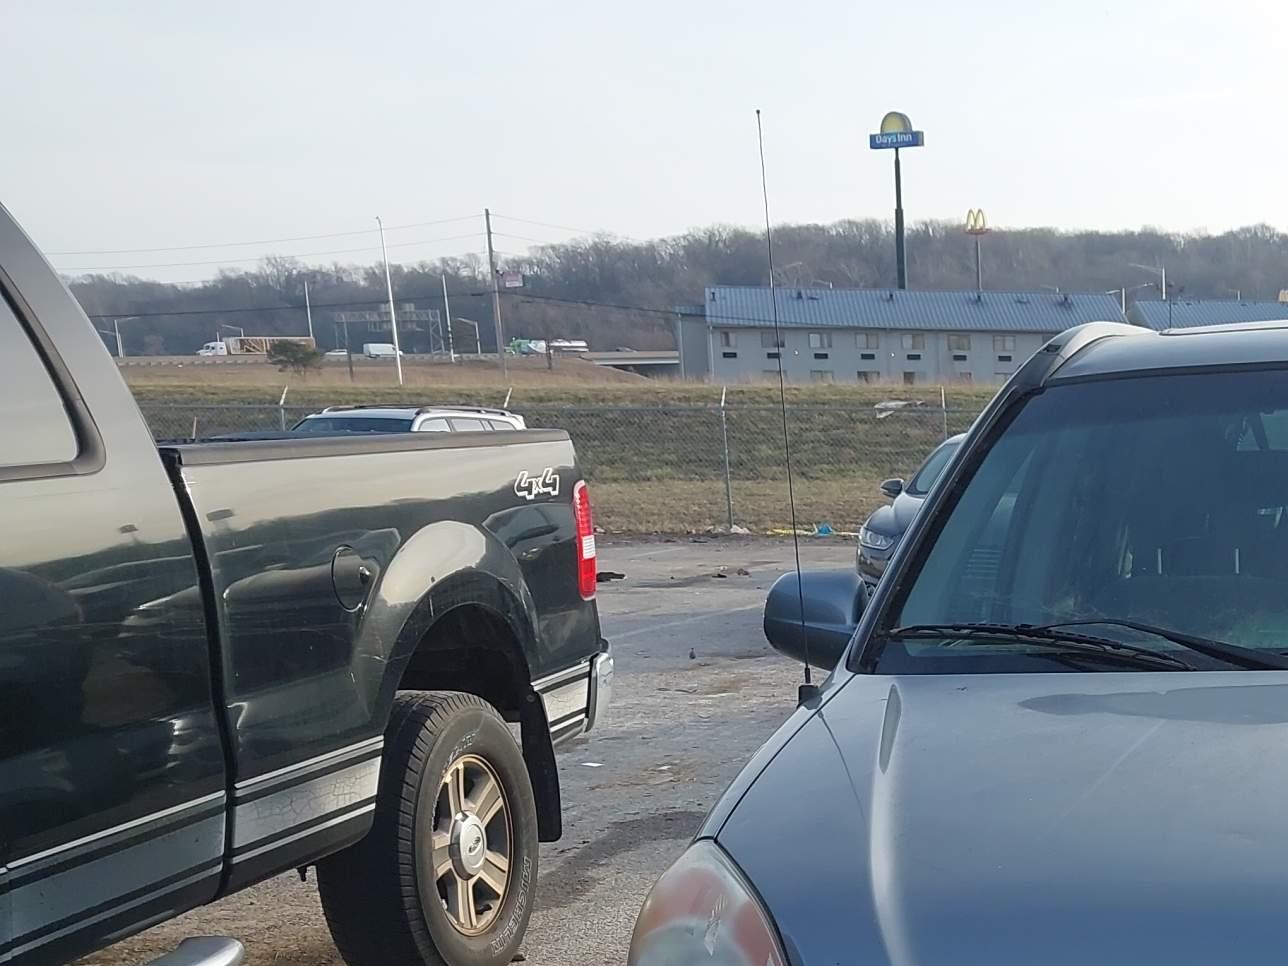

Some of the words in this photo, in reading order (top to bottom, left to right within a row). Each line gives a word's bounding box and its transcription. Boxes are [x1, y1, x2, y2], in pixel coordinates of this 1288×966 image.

[875, 133, 896, 145] Days
[897, 132, 912, 142] Inn
[514, 468, 559, 500] 4x4
[491, 856, 533, 955] MICHELIN
